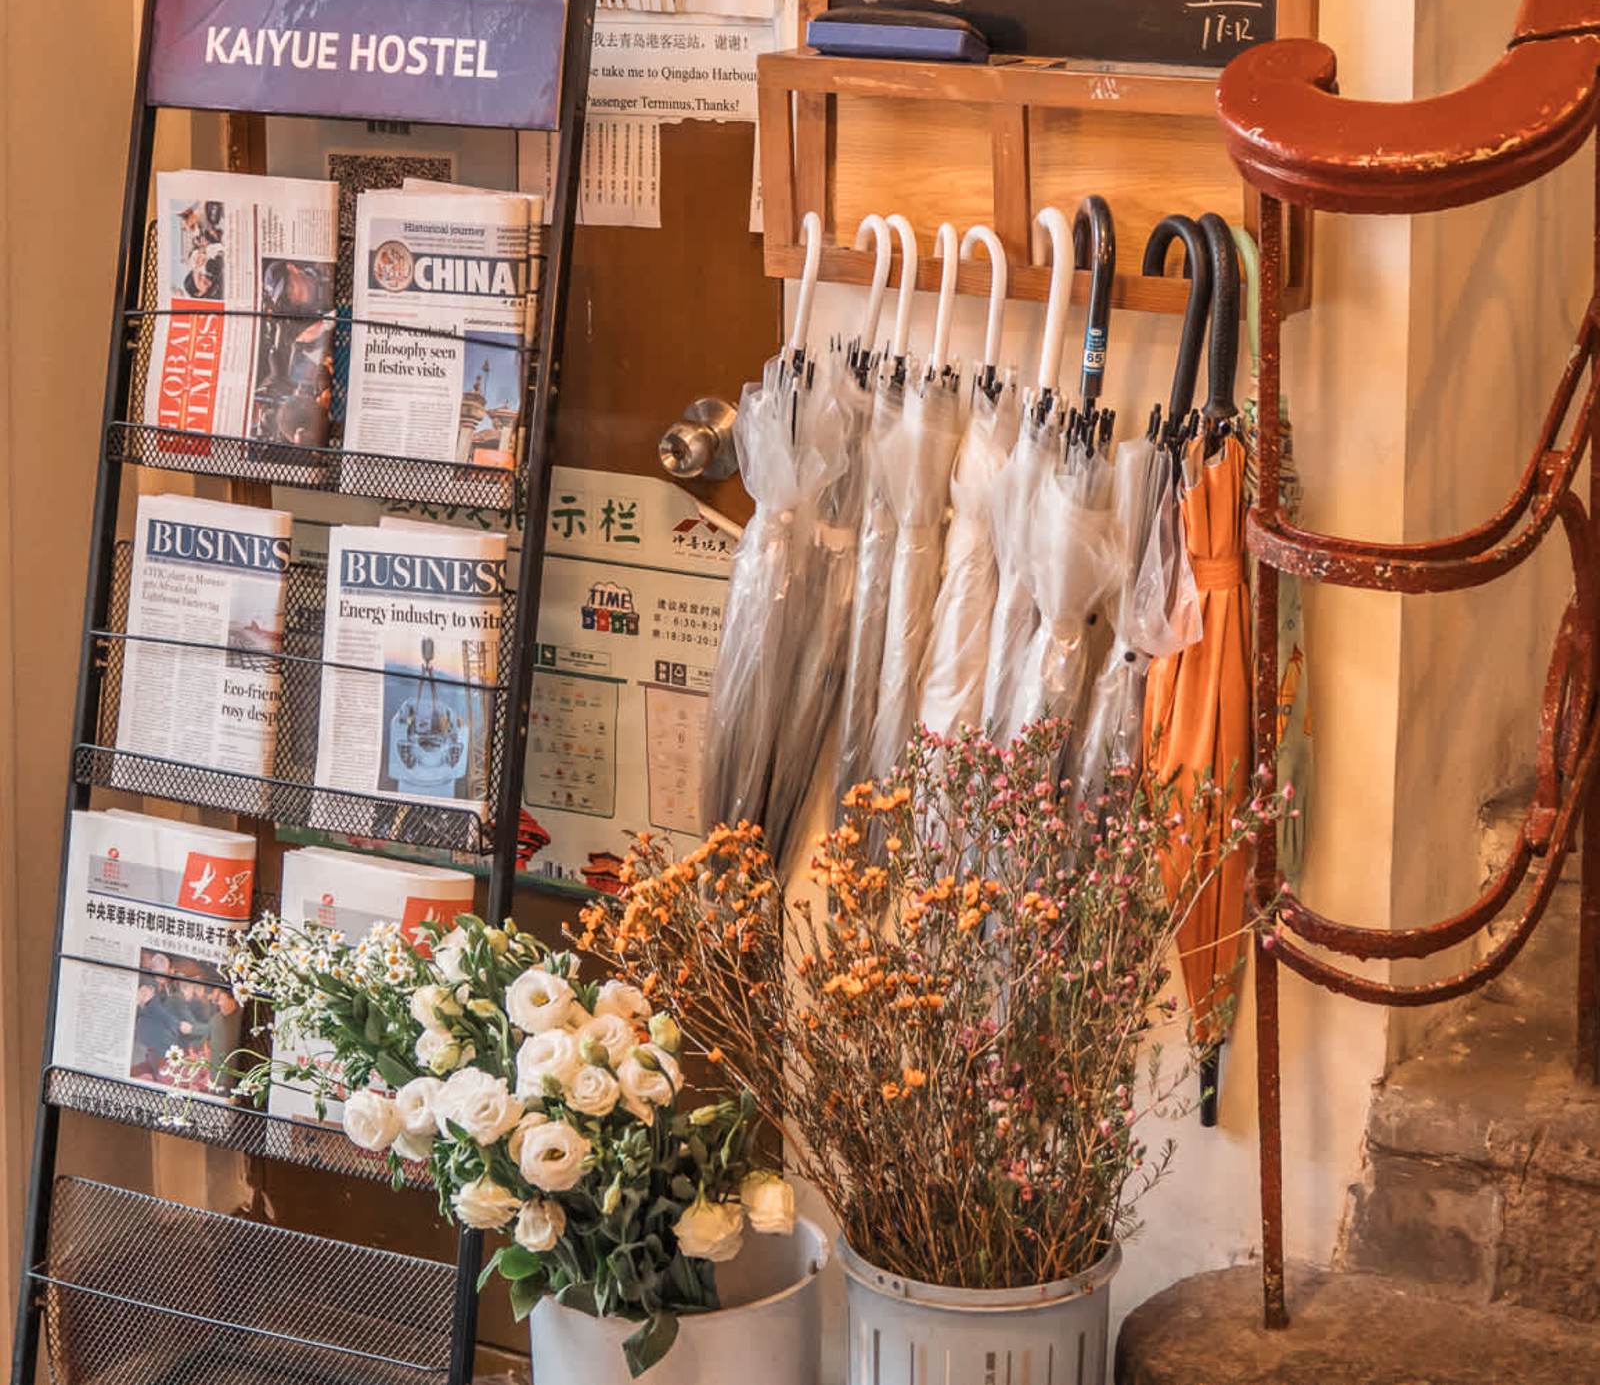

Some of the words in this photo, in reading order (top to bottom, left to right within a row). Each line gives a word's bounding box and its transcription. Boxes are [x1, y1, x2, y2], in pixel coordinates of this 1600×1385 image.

[1201, 14, 1255, 50] 17:12
[205, 26, 340, 69] KAIYUE
[349, 34, 499, 78] HOSTEL
[601, 65, 625, 78] take
[628, 69, 644, 78] me
[647, 68, 659, 78] to
[661, 66, 709, 82] Qingdao
[414, 256, 517, 295] CHINA
[366, 338, 427, 362] philosophy
[430, 346, 457, 360] seen
[364, 361, 376, 373] in
[378, 359, 415, 376] festive
[417, 361, 447, 378] visits
[588, 587, 633, 610] TIME
[339, 600, 387, 625] Energy
[391, 603, 449, 631] industry
[452, 611, 466, 628] to
[222, 704, 244, 722] rosy
